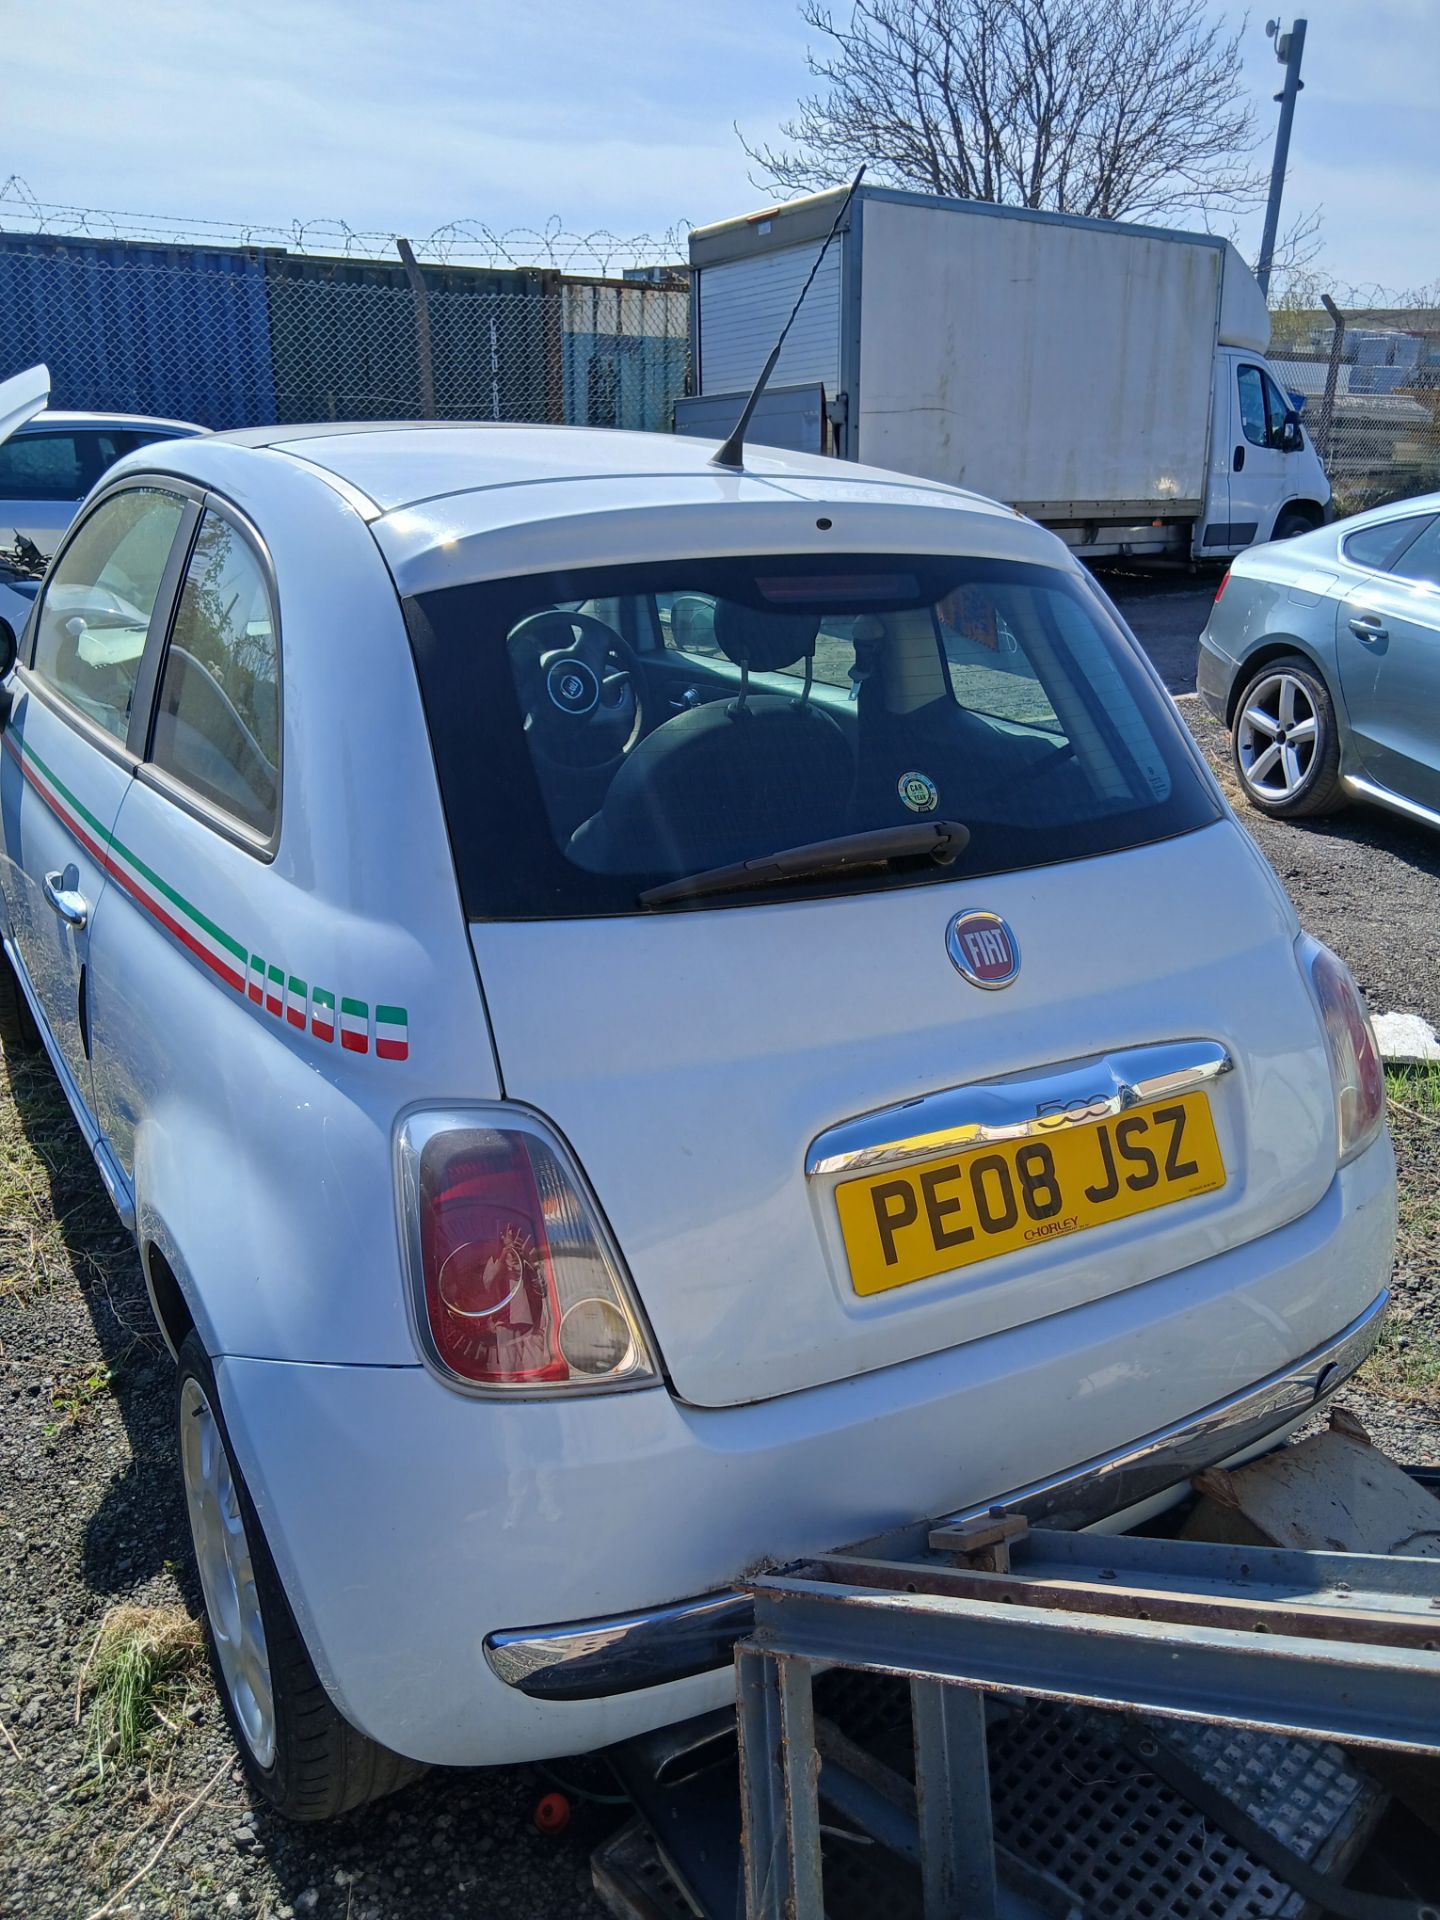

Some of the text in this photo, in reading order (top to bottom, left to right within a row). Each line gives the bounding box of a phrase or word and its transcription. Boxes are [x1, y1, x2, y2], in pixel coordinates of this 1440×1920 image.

[909, 784, 923, 792] CAR
[964, 929, 1008, 967] FIAT
[1036, 1094, 1112, 1129] 500
[870, 1104, 1198, 1266] PE08 JSZ
[1024, 1216, 1078, 1240] CHORLEY
